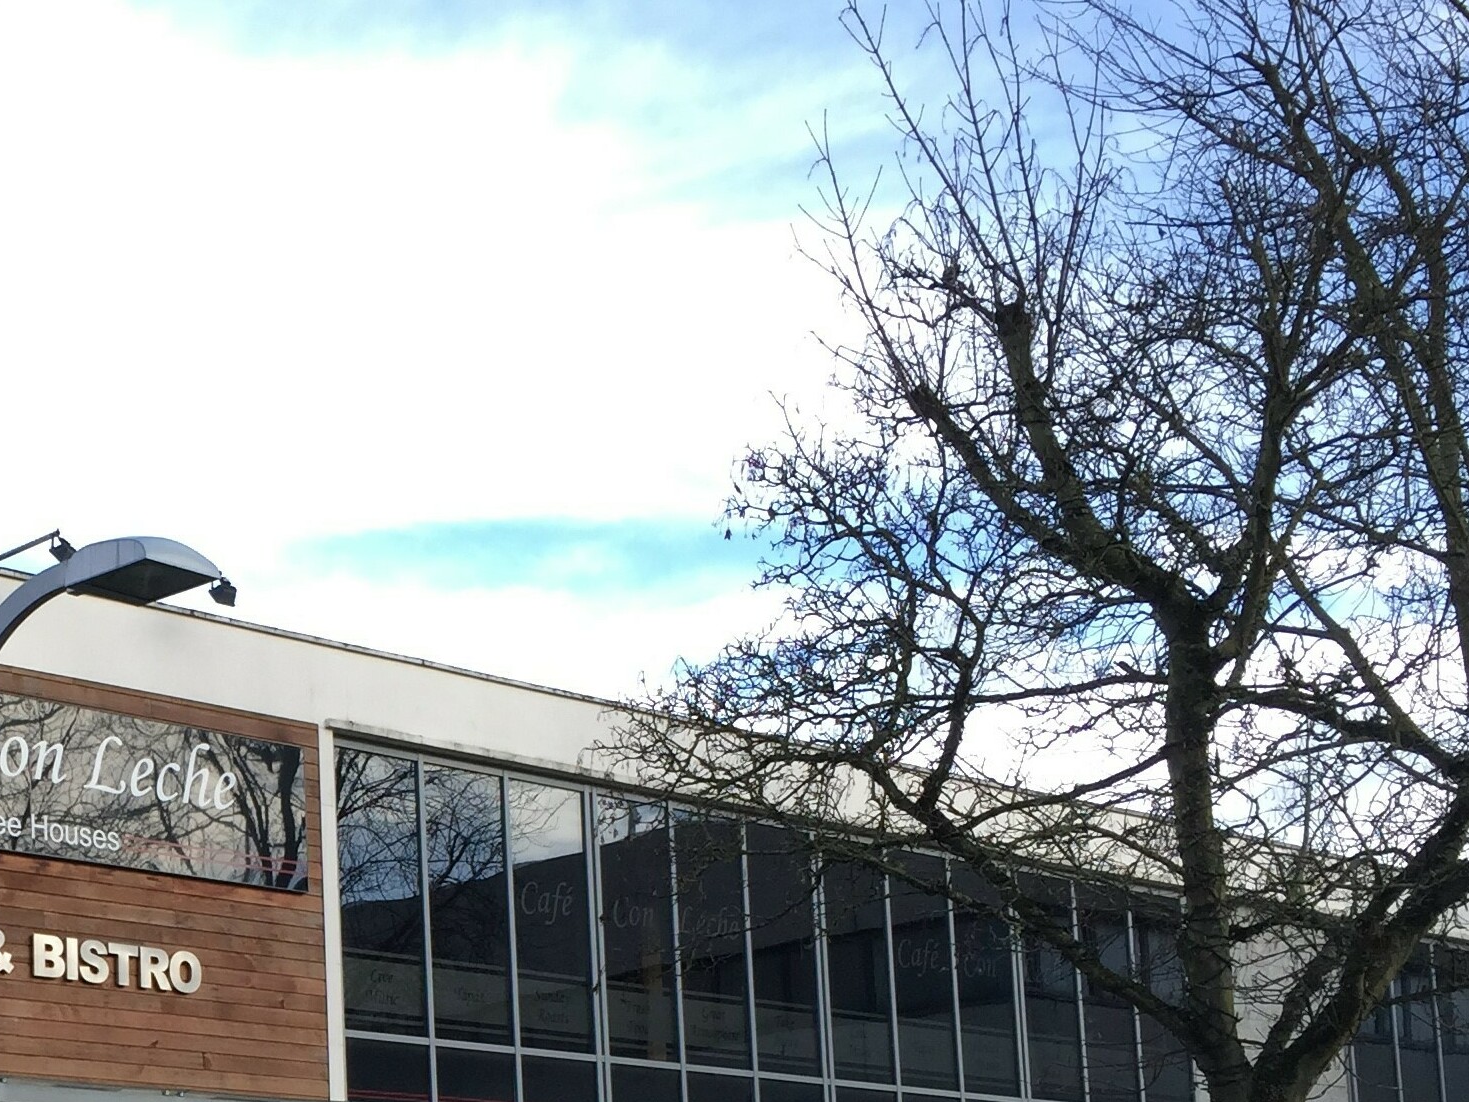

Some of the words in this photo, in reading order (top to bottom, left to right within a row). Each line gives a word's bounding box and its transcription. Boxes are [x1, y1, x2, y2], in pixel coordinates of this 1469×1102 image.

[84, 735, 238, 811] Leche
[31, 813, 122, 852] Houses
[520, 879, 574, 926] Café
[32, 933, 203, 995] BISTRO
